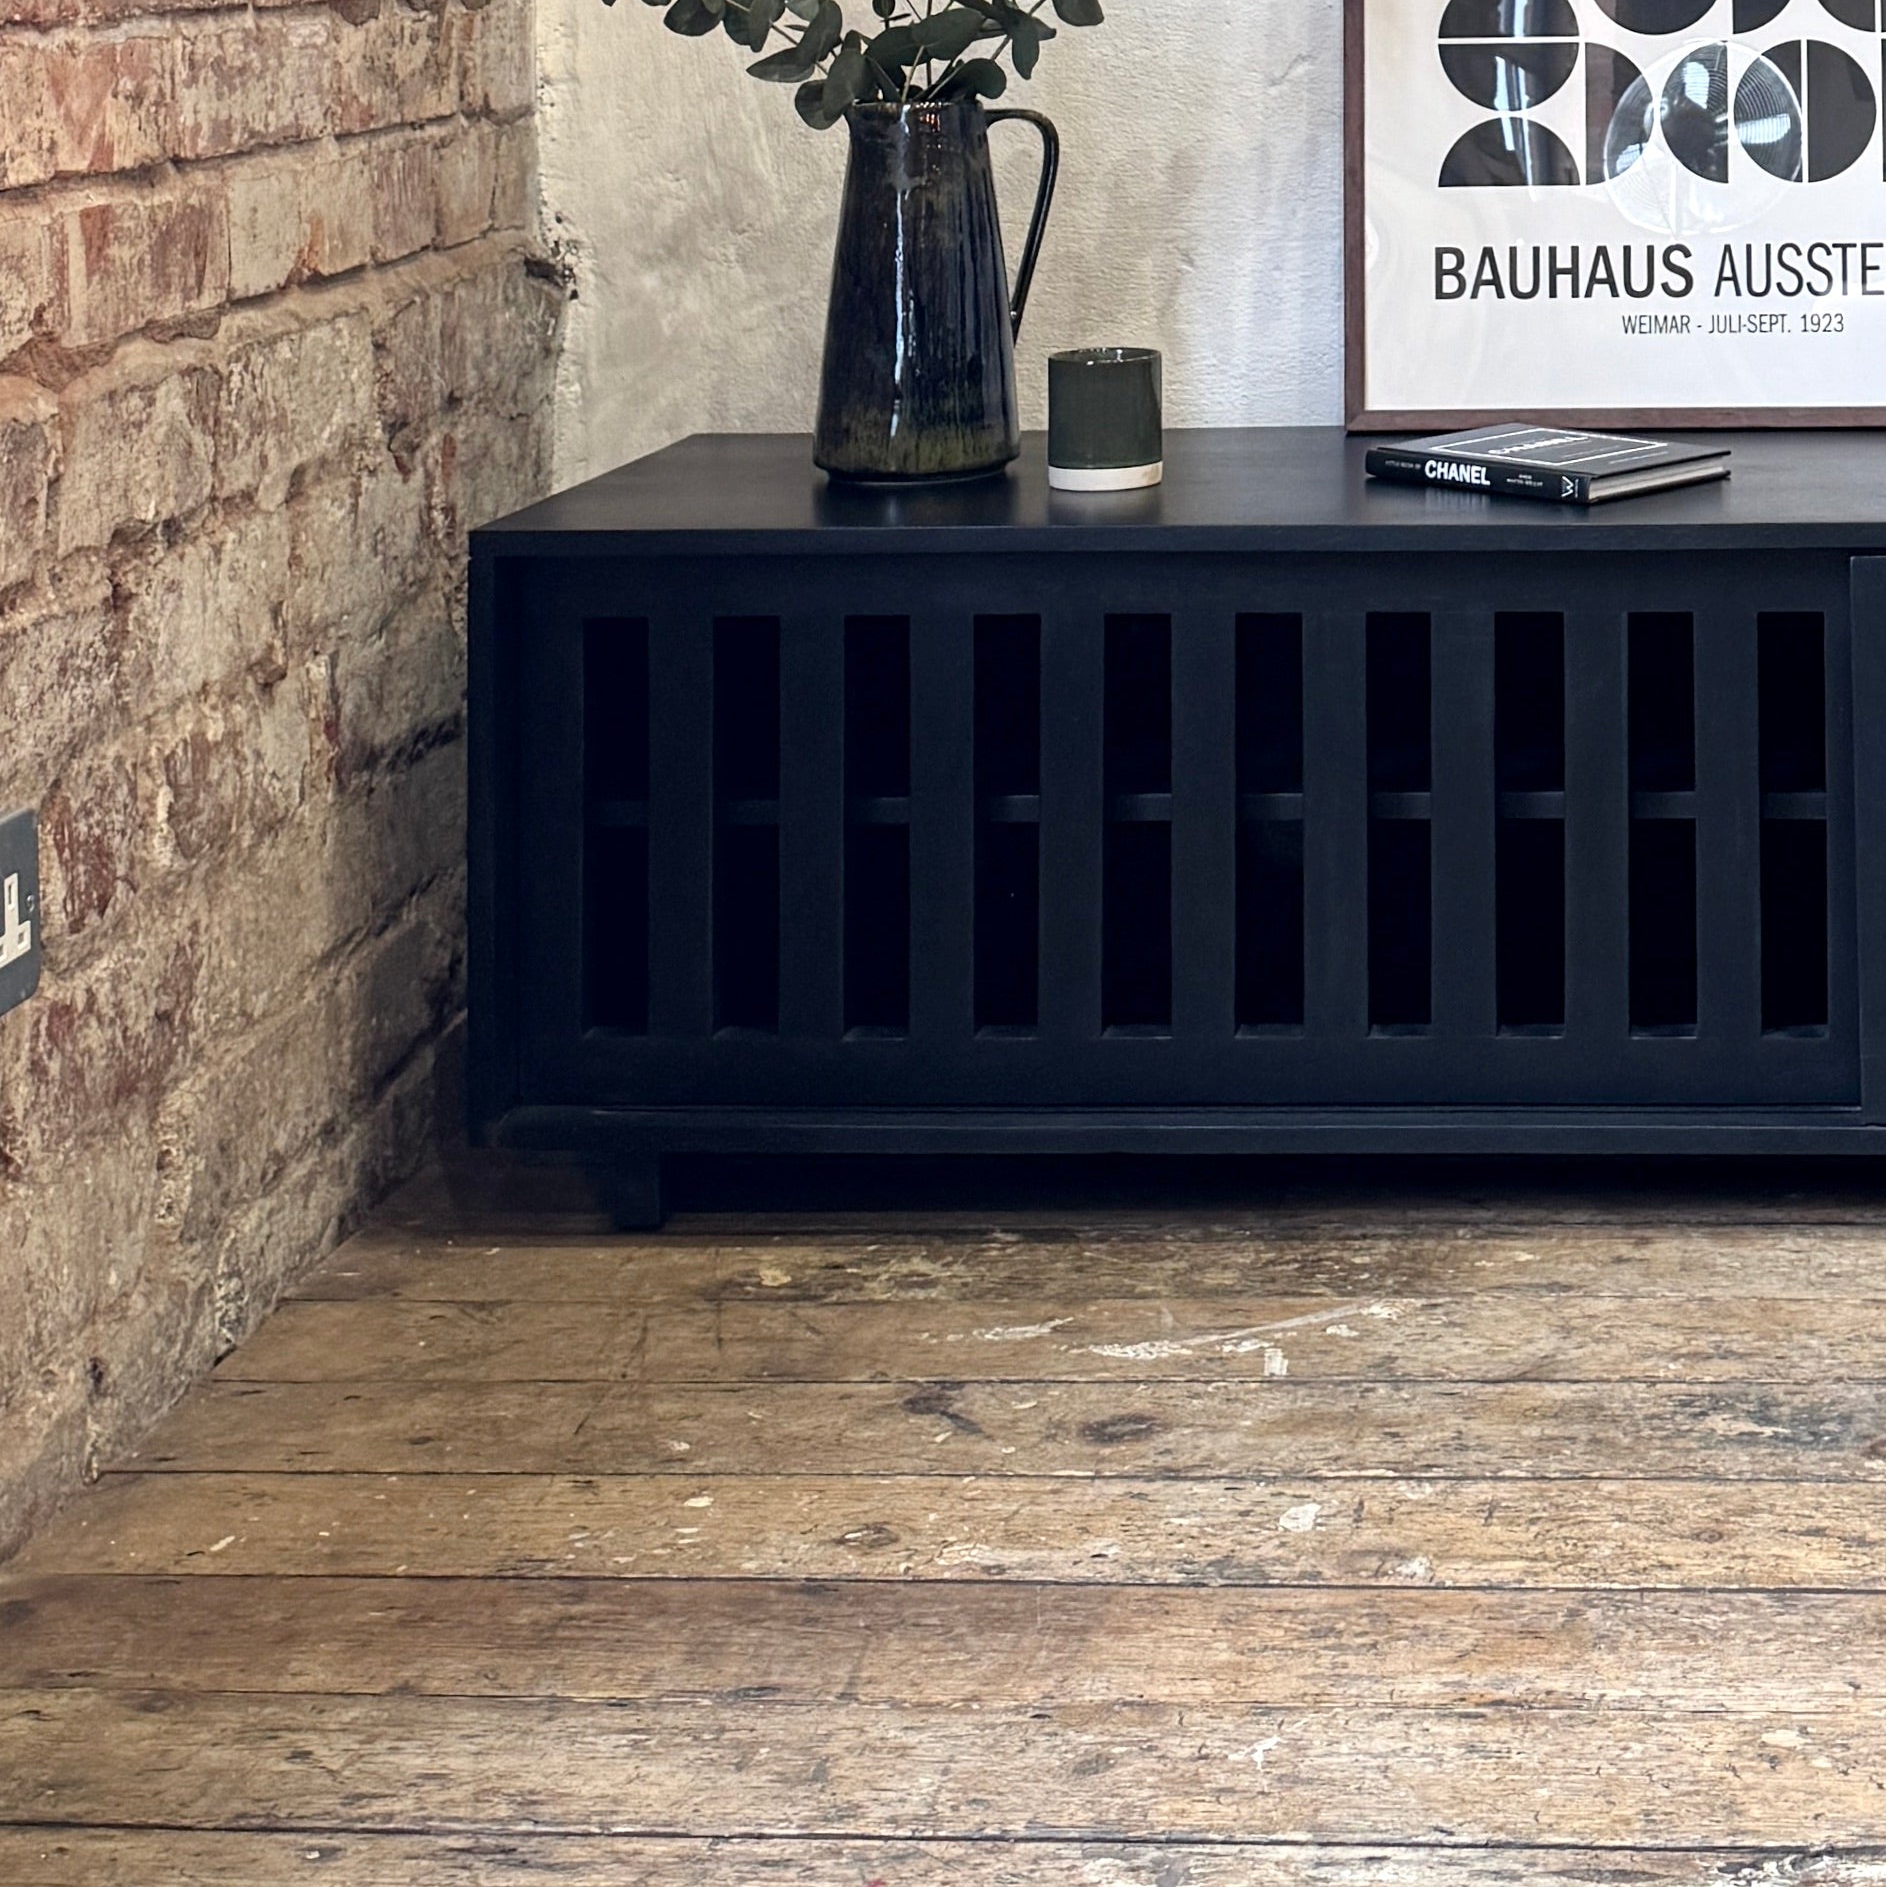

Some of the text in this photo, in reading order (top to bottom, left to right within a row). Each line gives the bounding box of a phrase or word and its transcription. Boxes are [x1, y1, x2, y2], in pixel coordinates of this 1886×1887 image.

[1434, 243, 1694, 300] BAUHAUS
[1622, 314, 1691, 335] WEIMAR
[1708, 313, 1792, 335] JULI-SEPT.
[1800, 313, 1845, 334] 1923
[1424, 459, 1491, 486] CHANEL
